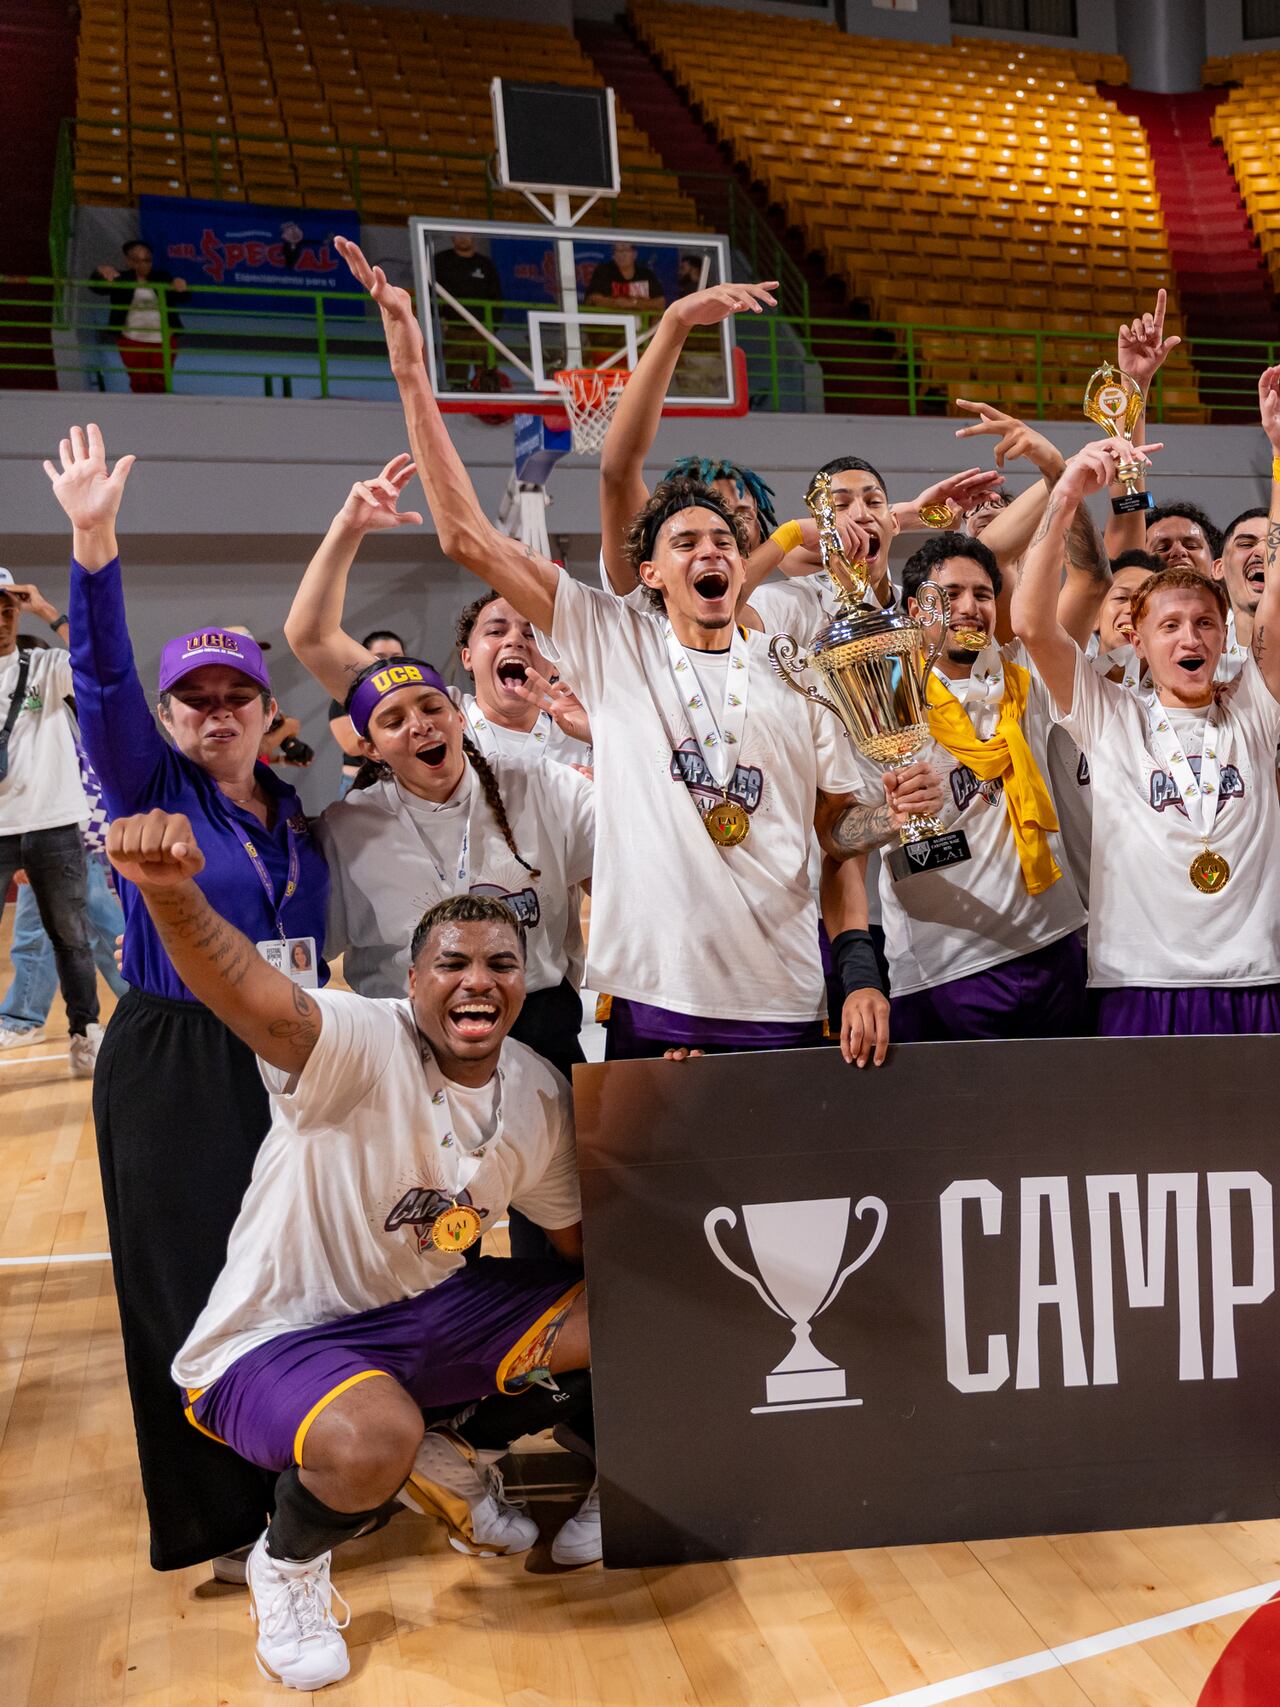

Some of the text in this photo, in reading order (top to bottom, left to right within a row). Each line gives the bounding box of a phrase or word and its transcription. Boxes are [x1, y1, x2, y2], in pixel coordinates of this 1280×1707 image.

[187, 634, 238, 651] UCB
[371, 665, 424, 693] UCB
[934, 848, 964, 863] LAI
